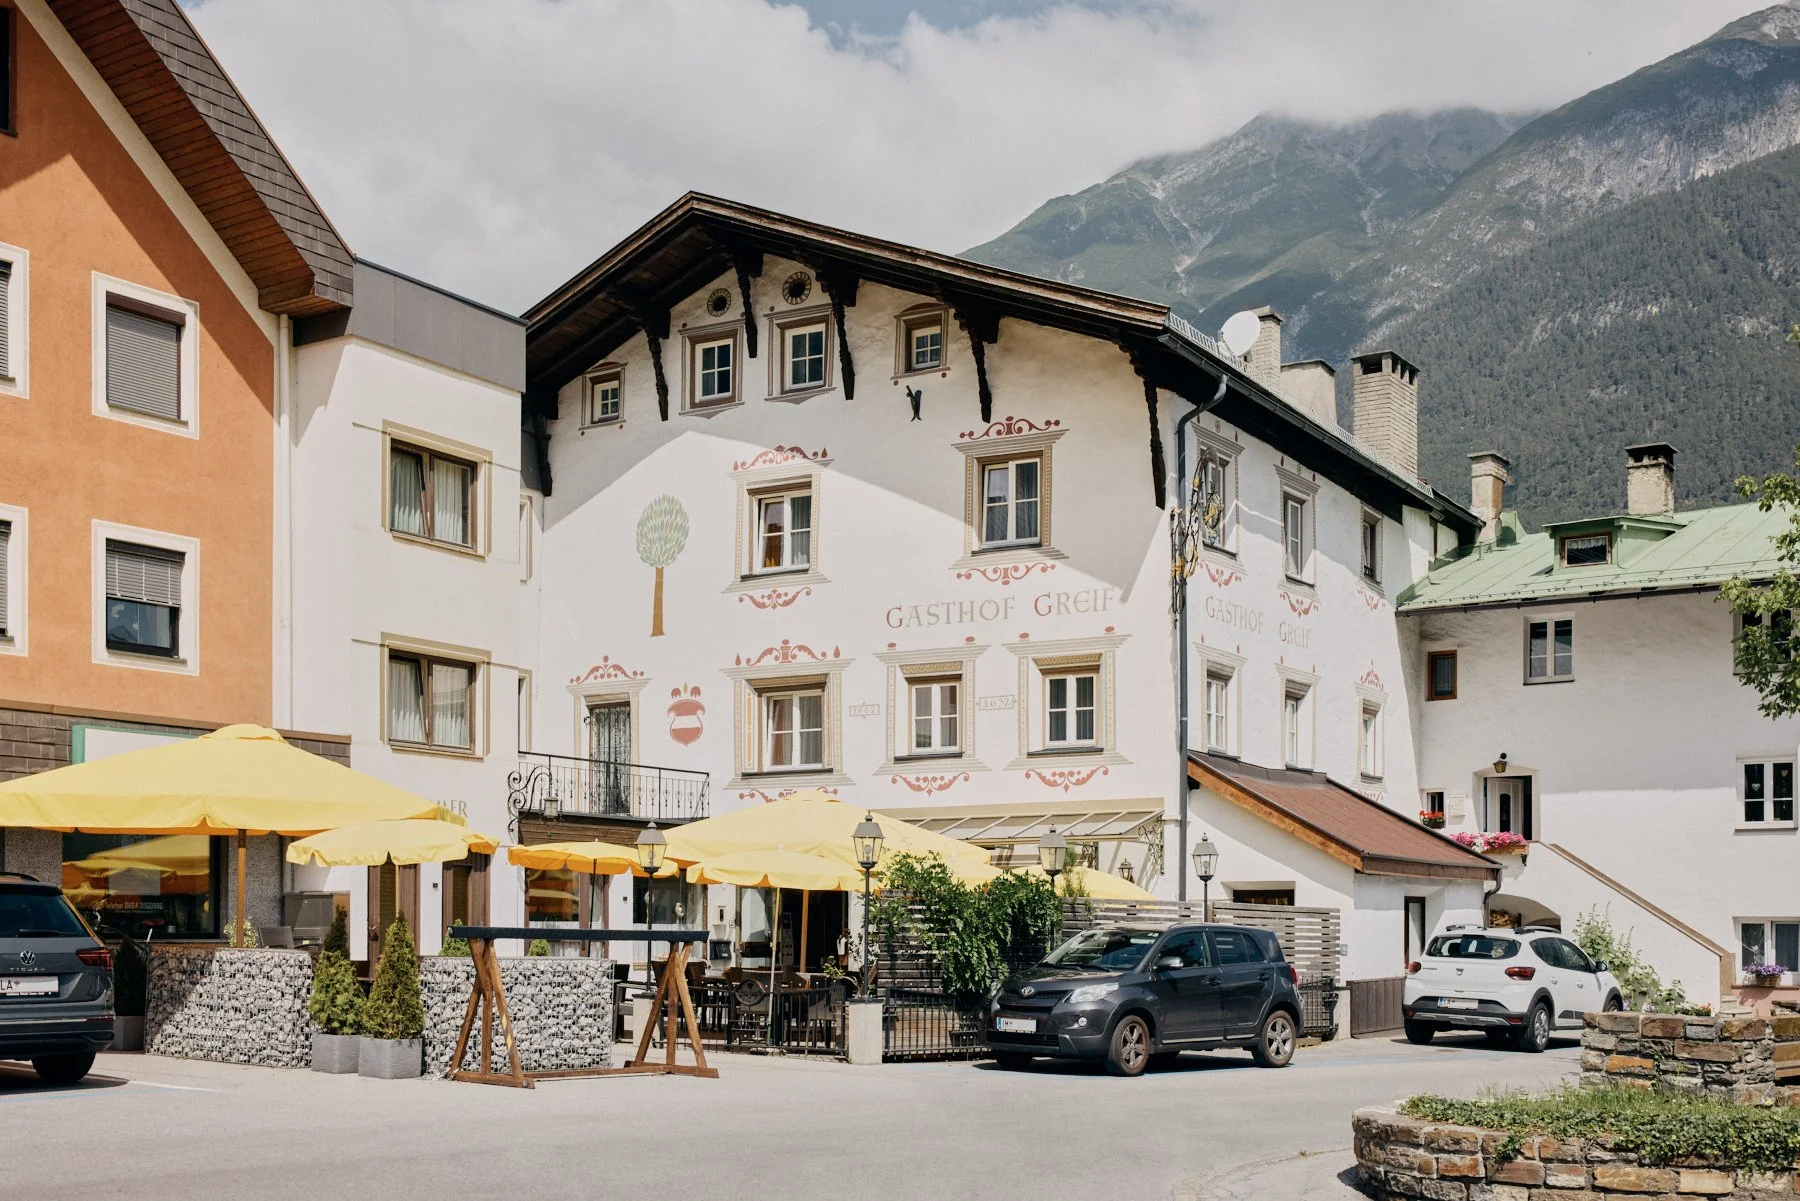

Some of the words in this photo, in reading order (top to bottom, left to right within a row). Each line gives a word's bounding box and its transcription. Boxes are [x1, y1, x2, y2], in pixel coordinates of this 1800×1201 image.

[886, 595, 1015, 628] GASTHOF
[1034, 586, 1115, 616] GREIF
[1206, 596, 1263, 635] GASTHOF
[1279, 621, 1312, 649] GREIF
